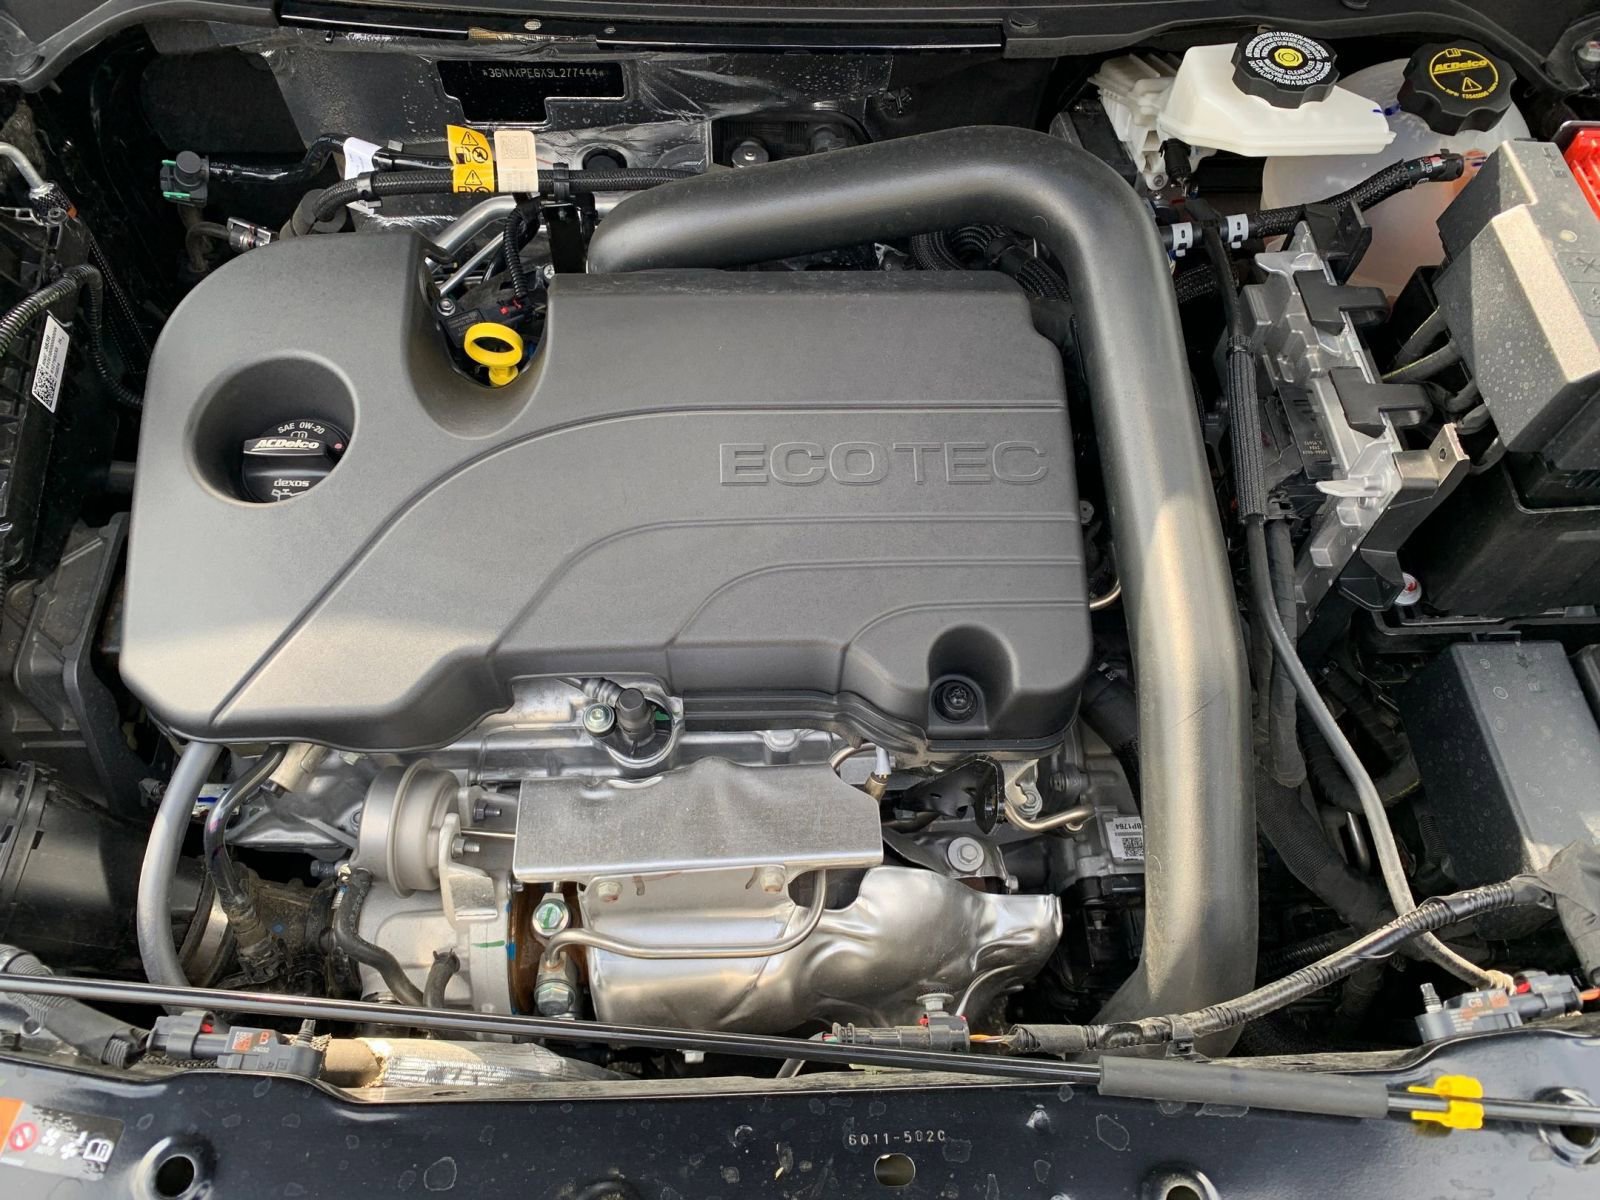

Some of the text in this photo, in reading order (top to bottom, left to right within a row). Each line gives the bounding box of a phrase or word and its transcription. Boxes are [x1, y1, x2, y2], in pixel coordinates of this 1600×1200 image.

[1434, 60, 1488, 72] ACDelco
[277, 421, 325, 435] SAE 0W-20
[254, 439, 320, 450] ACDelco
[719, 440, 1049, 486] ECOTEC
[273, 478, 311, 488] dexos
